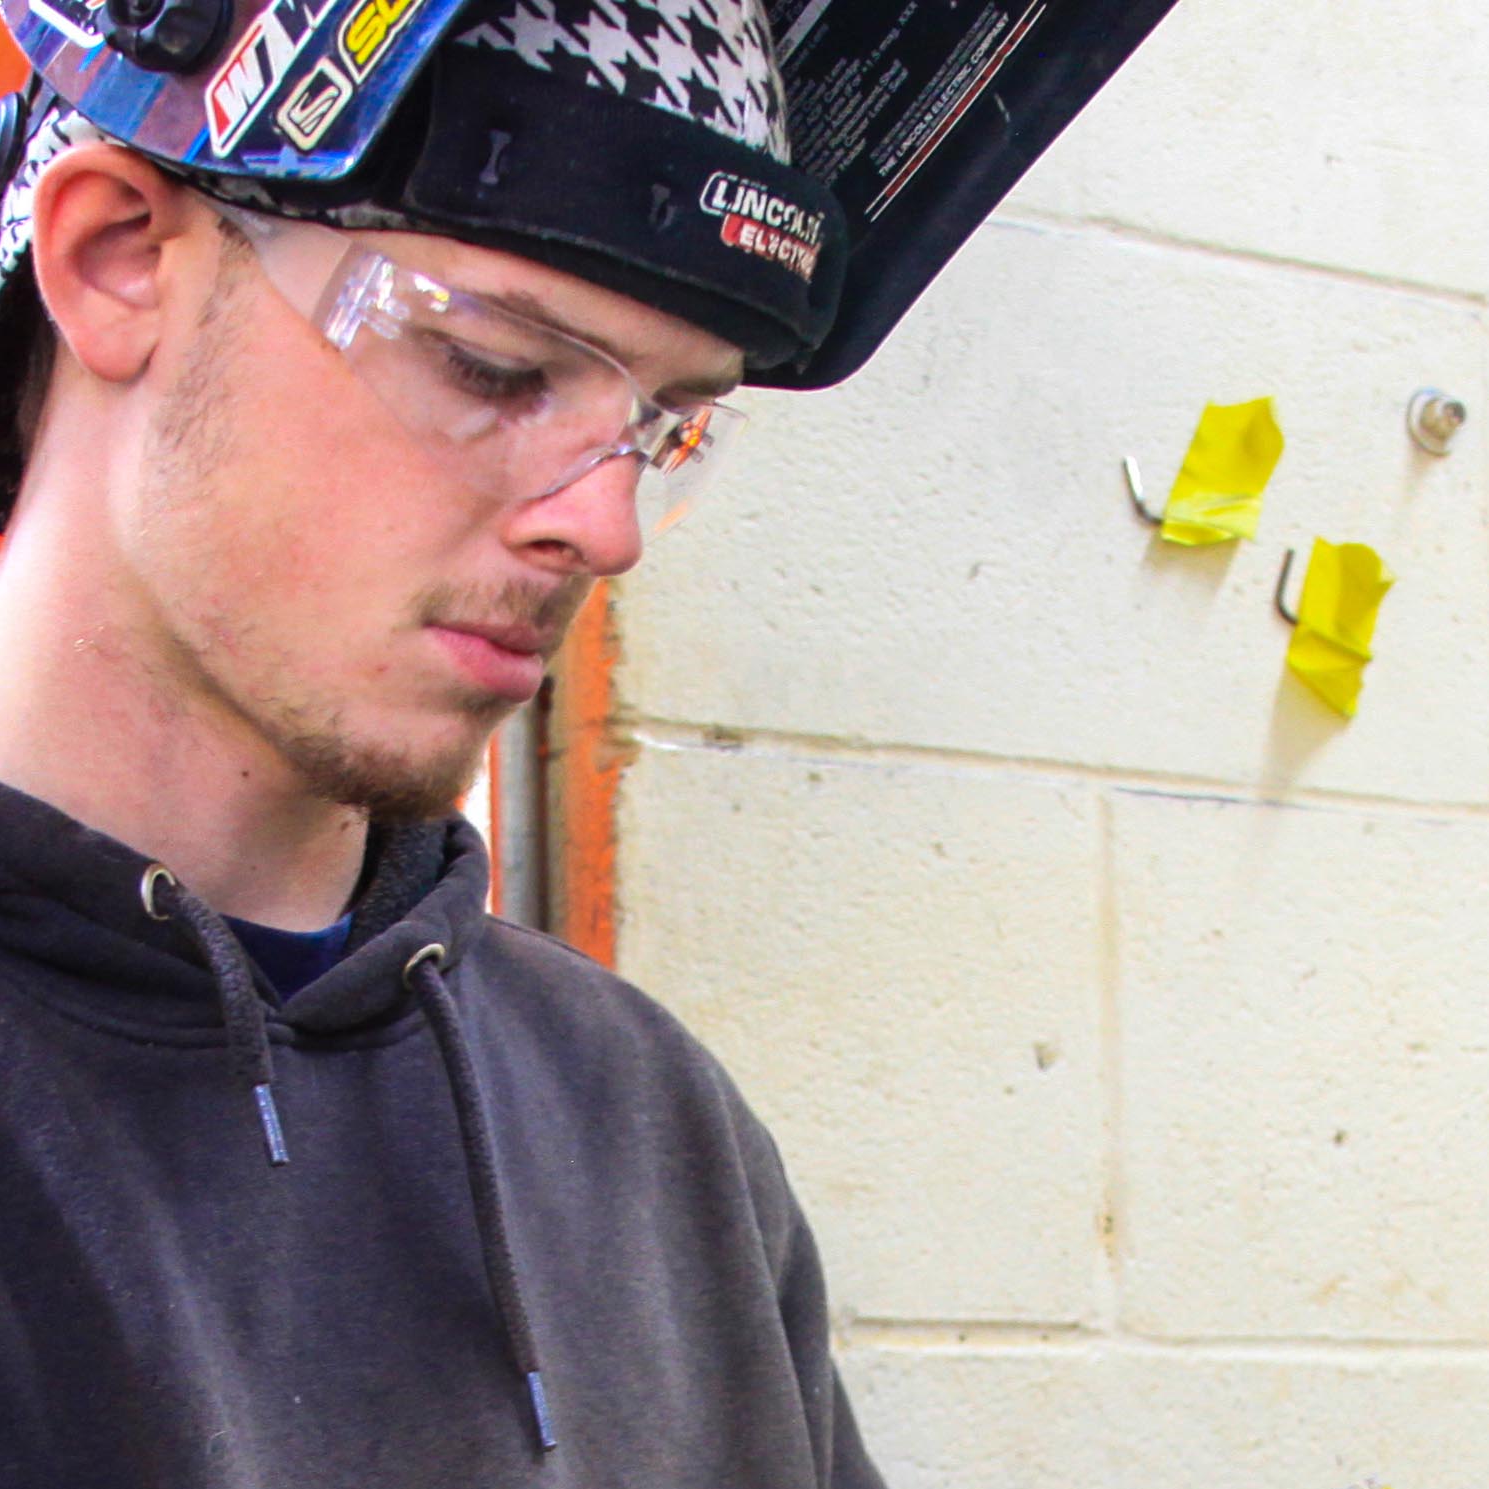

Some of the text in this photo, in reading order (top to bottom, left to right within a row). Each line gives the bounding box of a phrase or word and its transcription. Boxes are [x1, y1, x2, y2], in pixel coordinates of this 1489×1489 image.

[880, 157, 896, 176] THE
[896, 113, 932, 156] LINCOLN
[932, 65, 970, 112] ELECTRIC
[970, 13, 1010, 62] COMPANY
